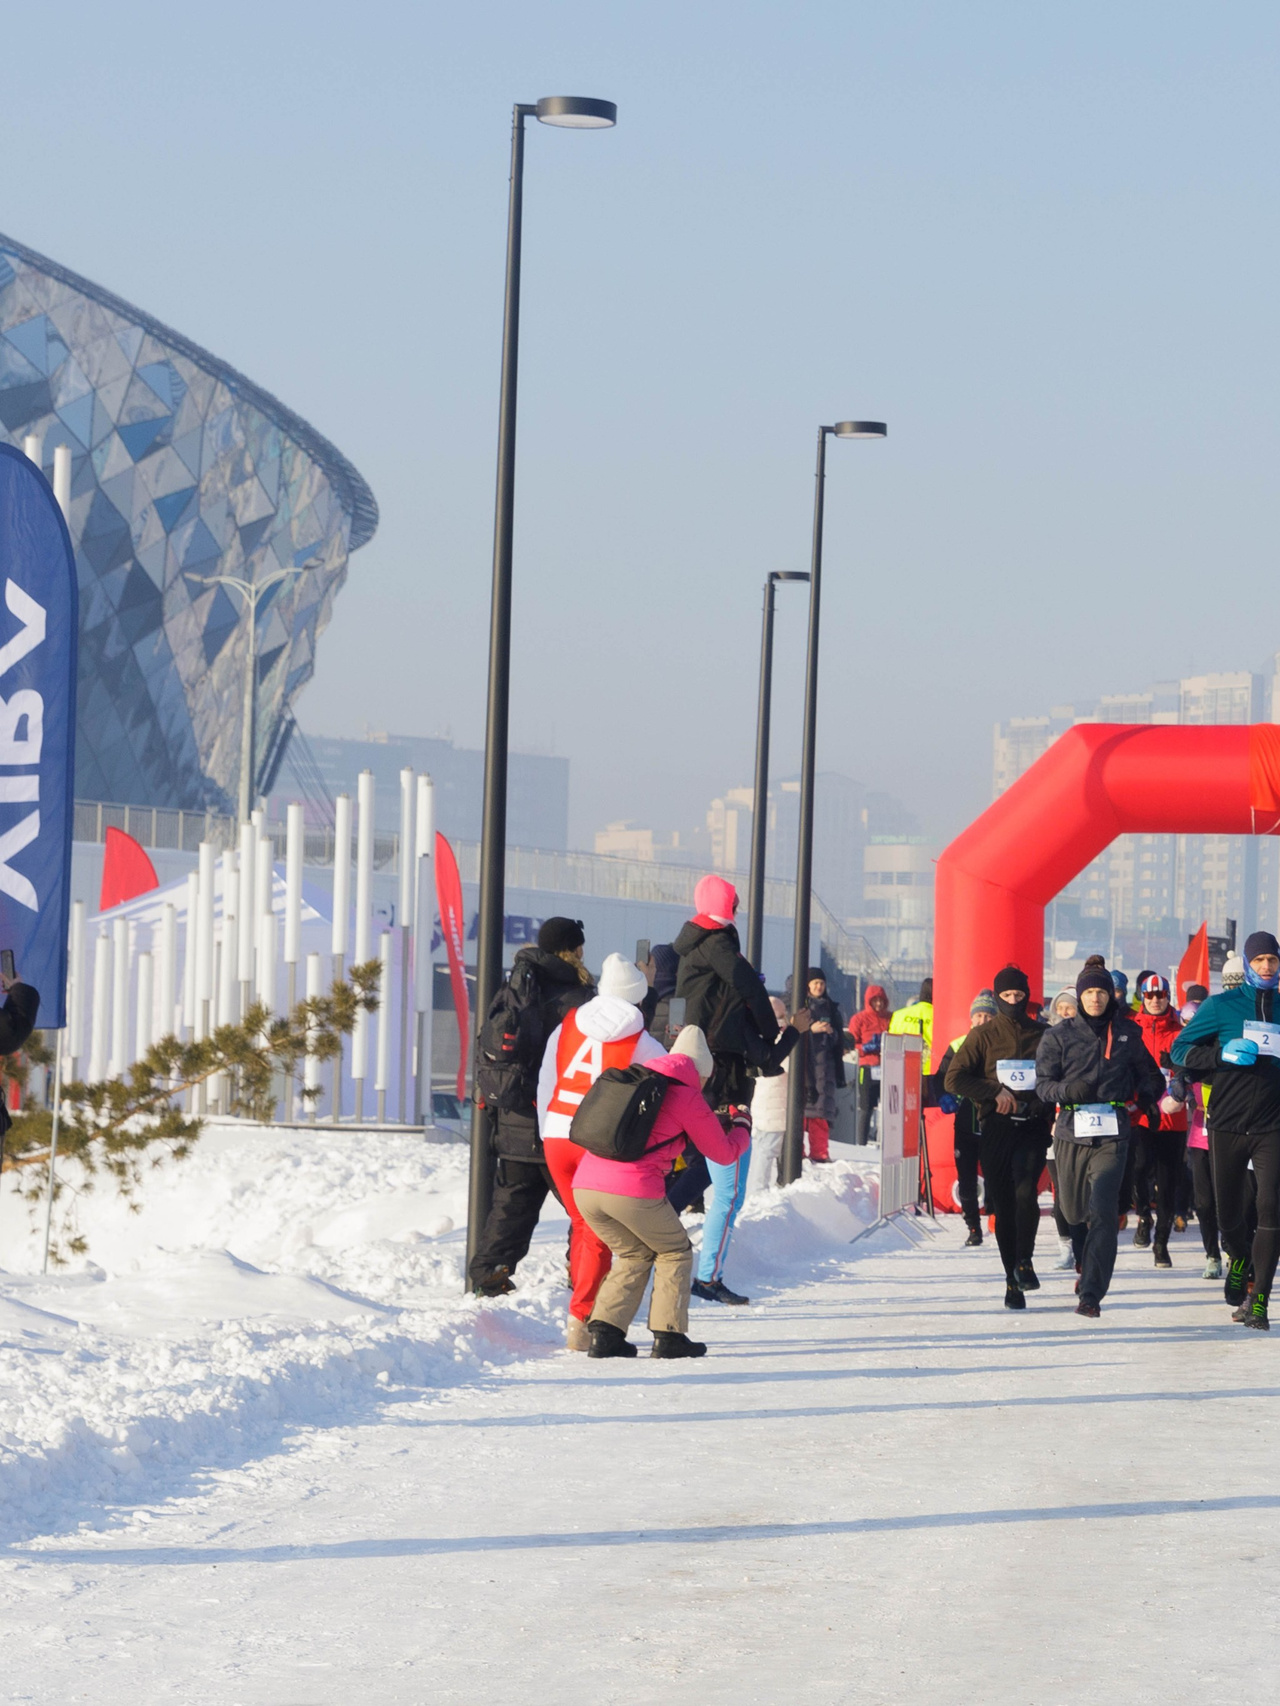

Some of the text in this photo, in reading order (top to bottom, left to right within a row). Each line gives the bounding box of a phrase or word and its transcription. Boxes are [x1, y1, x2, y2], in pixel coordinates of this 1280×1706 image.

[1262, 1034, 1270, 1045] 2
[1010, 1071, 1025, 1081] 63
[1089, 1116, 1102, 1127] 21
